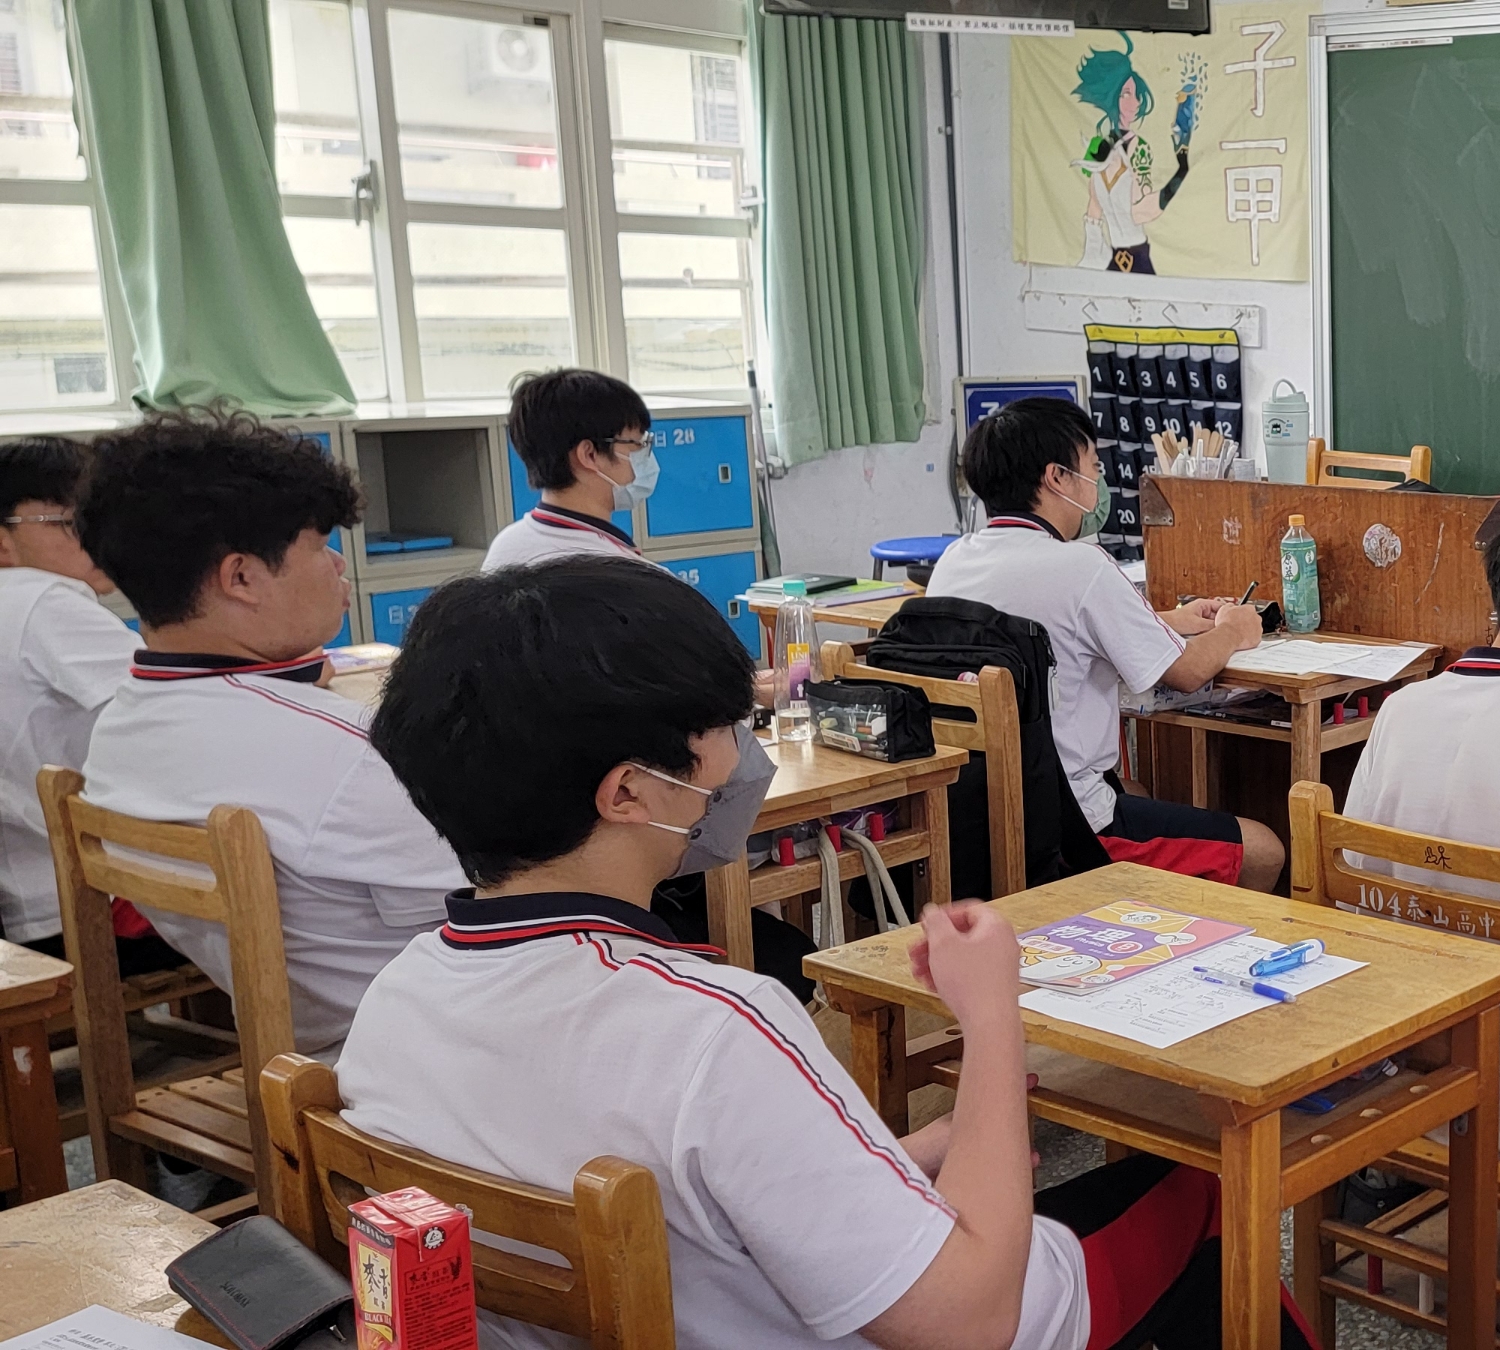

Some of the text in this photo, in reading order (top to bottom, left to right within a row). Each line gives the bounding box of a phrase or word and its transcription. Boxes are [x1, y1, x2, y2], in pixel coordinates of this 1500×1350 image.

[1219, 20, 1297, 266] 子一甲
[1093, 366, 1227, 390] 1 2 3 4 5 6
[673, 428, 695, 446] 28
[1093, 412, 1103, 428] 7
[1119, 416, 1130, 433] 8
[1144, 416, 1156, 432] 9
[1163, 418, 1181, 434] 10
[1214, 421, 1232, 438] 12
[1118, 463, 1133, 480] 14
[1117, 509, 1135, 524] 20
[1283, 551, 1294, 582] 原萃
[1047, 925, 1136, 943] 物理
[362, 1253, 391, 1300] 麥香
